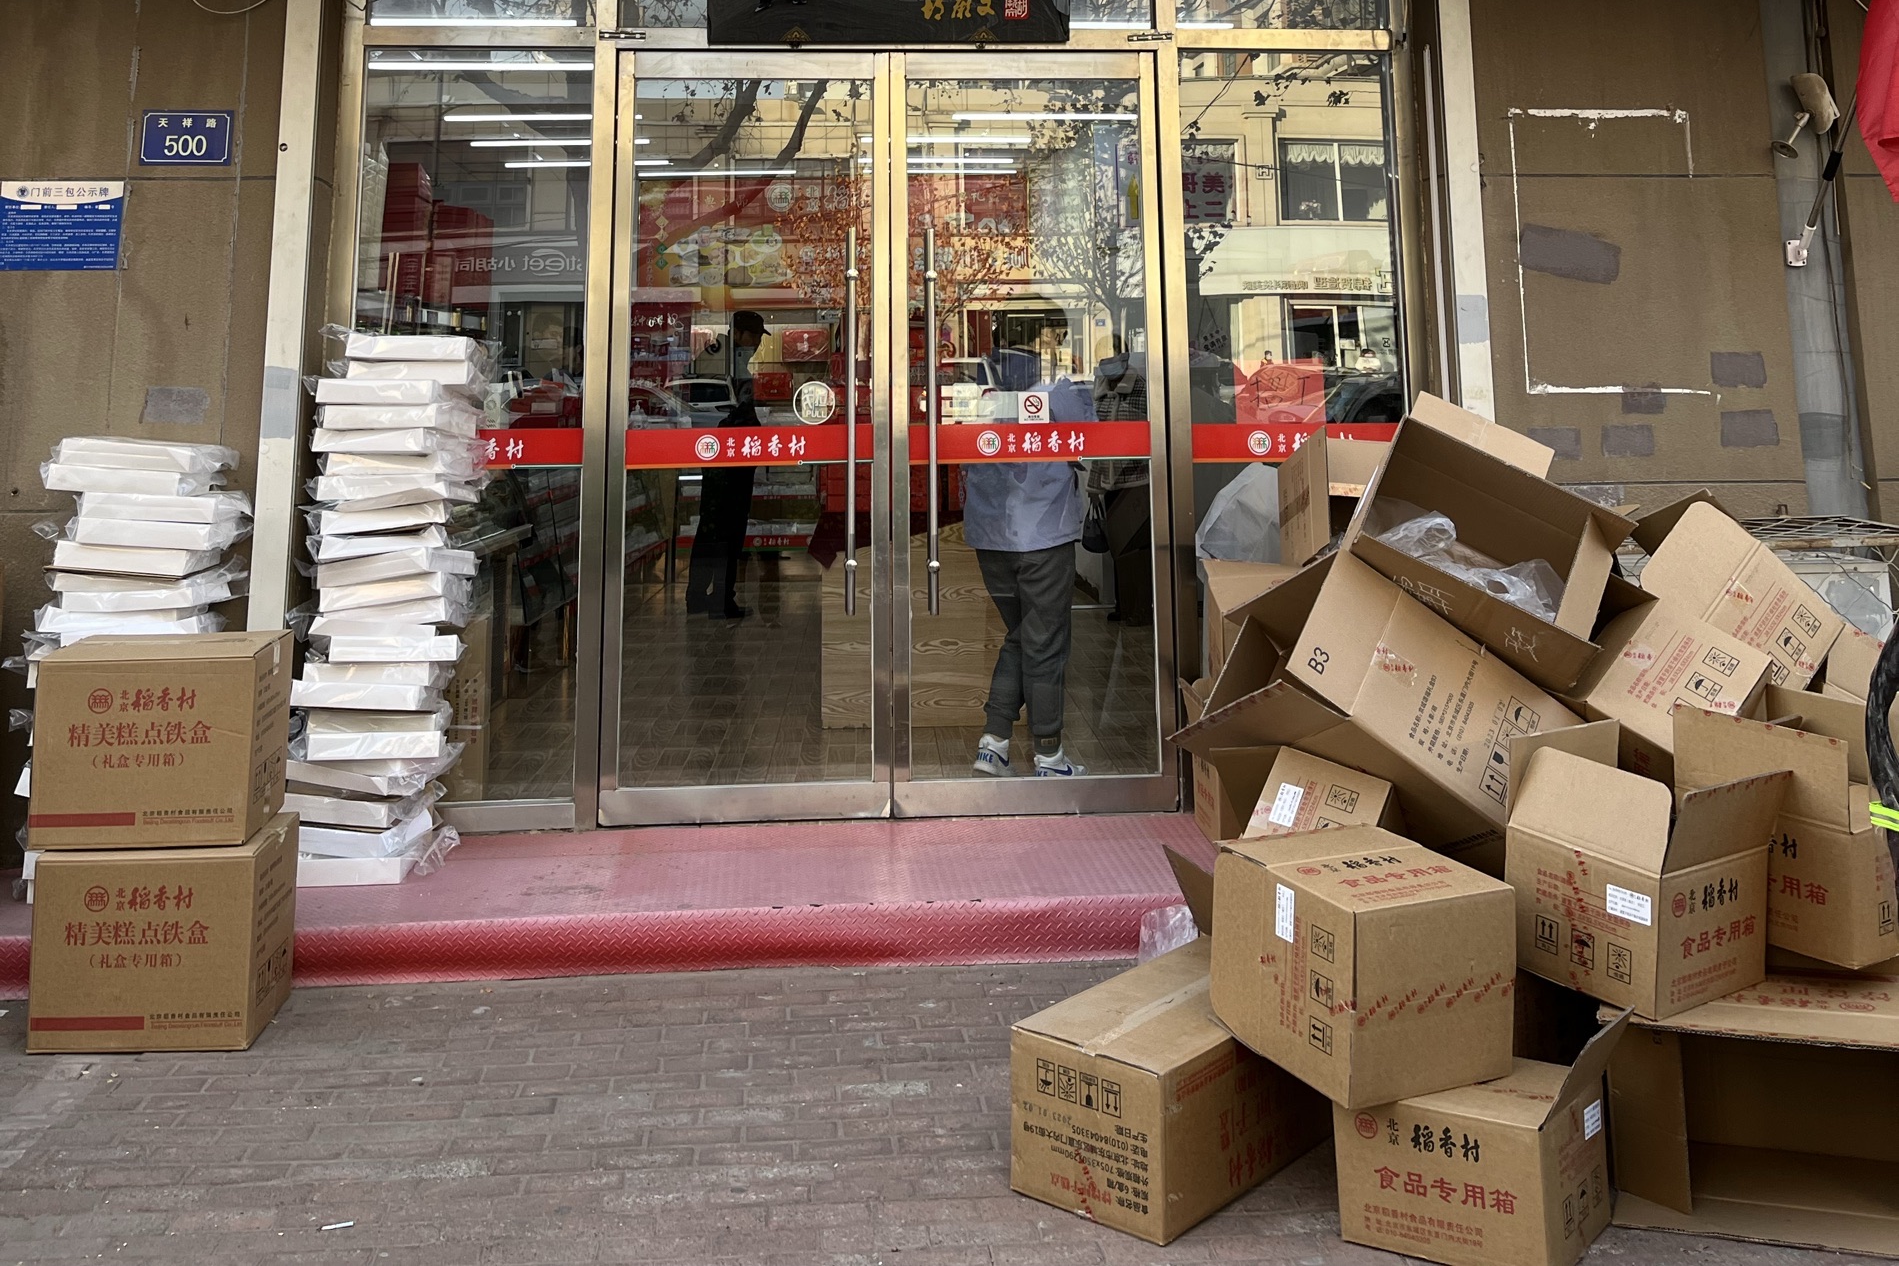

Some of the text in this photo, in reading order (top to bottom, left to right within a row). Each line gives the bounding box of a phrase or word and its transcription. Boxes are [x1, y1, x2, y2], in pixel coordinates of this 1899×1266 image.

[158, 117, 217, 128] 天祥路
[164, 135, 207, 156] 500
[30, 187, 110, 198] 门前三包公示牌
[806, 409, 827, 418] PULL
[726, 434, 806, 458] 北京 稻香村
[1007, 430, 1085, 454] 北京 稻香村
[1277, 433, 1287, 453] 北京
[1307, 646, 1330, 675] B3
[119, 687, 197, 713] 北京 稻香村
[67, 720, 212, 747] 精美糕点铁盒
[1338, 865, 1452, 888] 食品专用箱
[115, 885, 193, 912] 北京 稻香村
[1688, 877, 1739, 915] 北京 稻香村
[64, 920, 210, 947] 精美糕点铁盒
[1680, 915, 1757, 961] 食品专用箱
[1052, 1111, 1072, 1126] 2023
[1023, 1121, 1130, 1165] 北京市东城区东直门内大街19号
[1071, 1124, 1130, 1152] (010)84043305
[1114, 1124, 1149, 1144] 生产日期:
[1386, 1118, 1480, 1163] 北京 稻香村
[1106, 1178, 1130, 1195] 6盒/箱
[1115, 1167, 1149, 1187] 外箱规格:
[1374, 1166, 1518, 1215] 食品专用箱
[1114, 1196, 1149, 1215] 食品名称:
